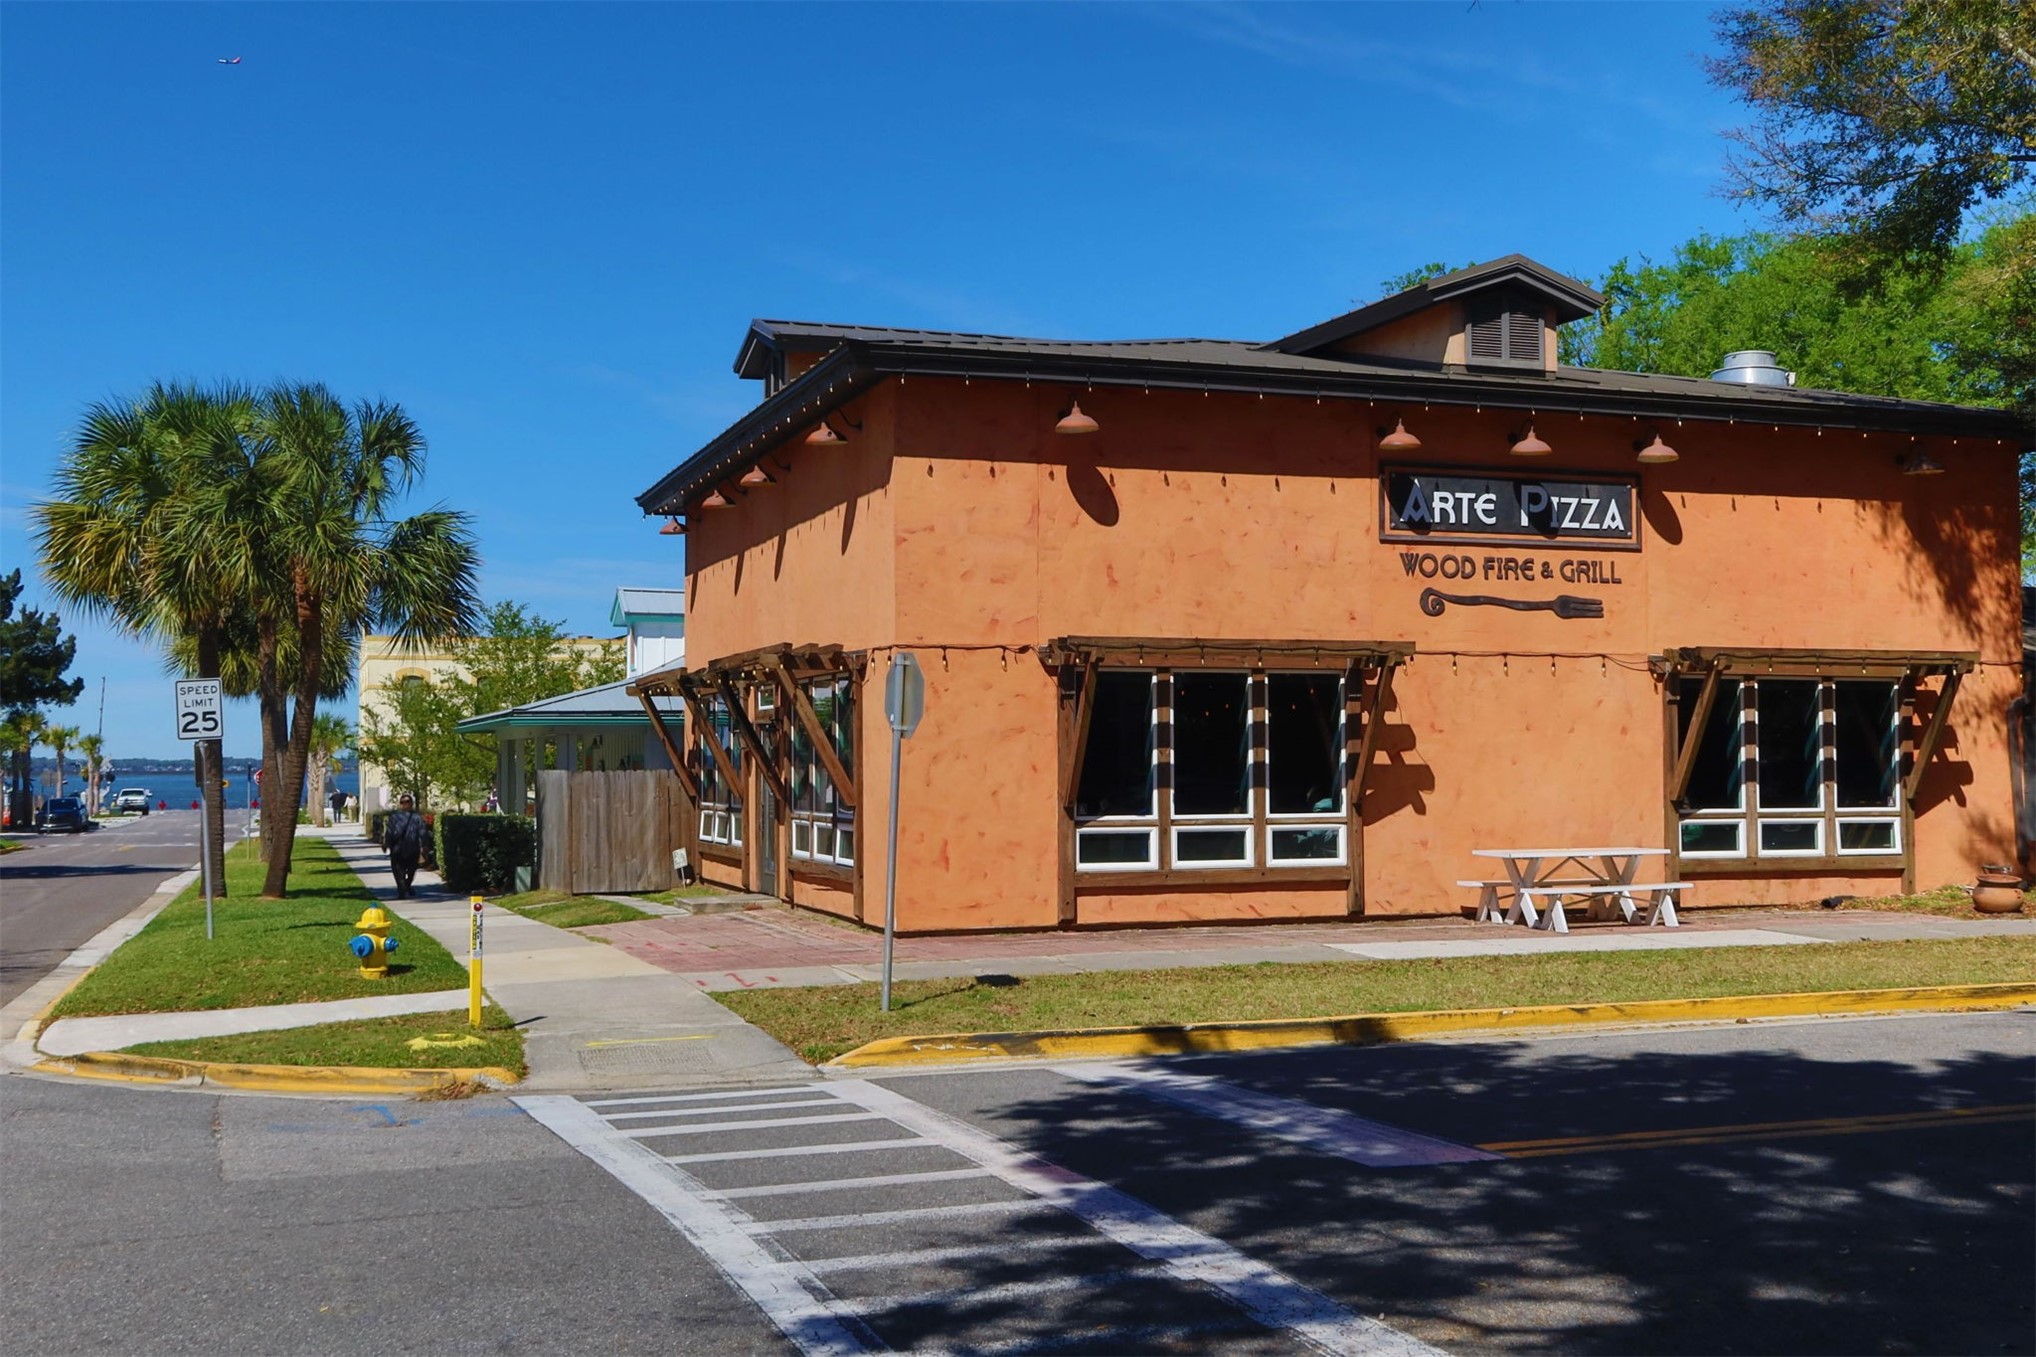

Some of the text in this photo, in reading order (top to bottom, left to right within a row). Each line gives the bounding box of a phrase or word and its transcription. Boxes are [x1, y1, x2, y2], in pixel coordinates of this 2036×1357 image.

[1400, 478, 1625, 531] ARTE PIZZA
[1399, 552, 1622, 584] WOOD FIRE & GRILL
[179, 685, 218, 696] SPEED
[184, 698, 213, 708] LIMIT
[181, 710, 219, 733] 25
